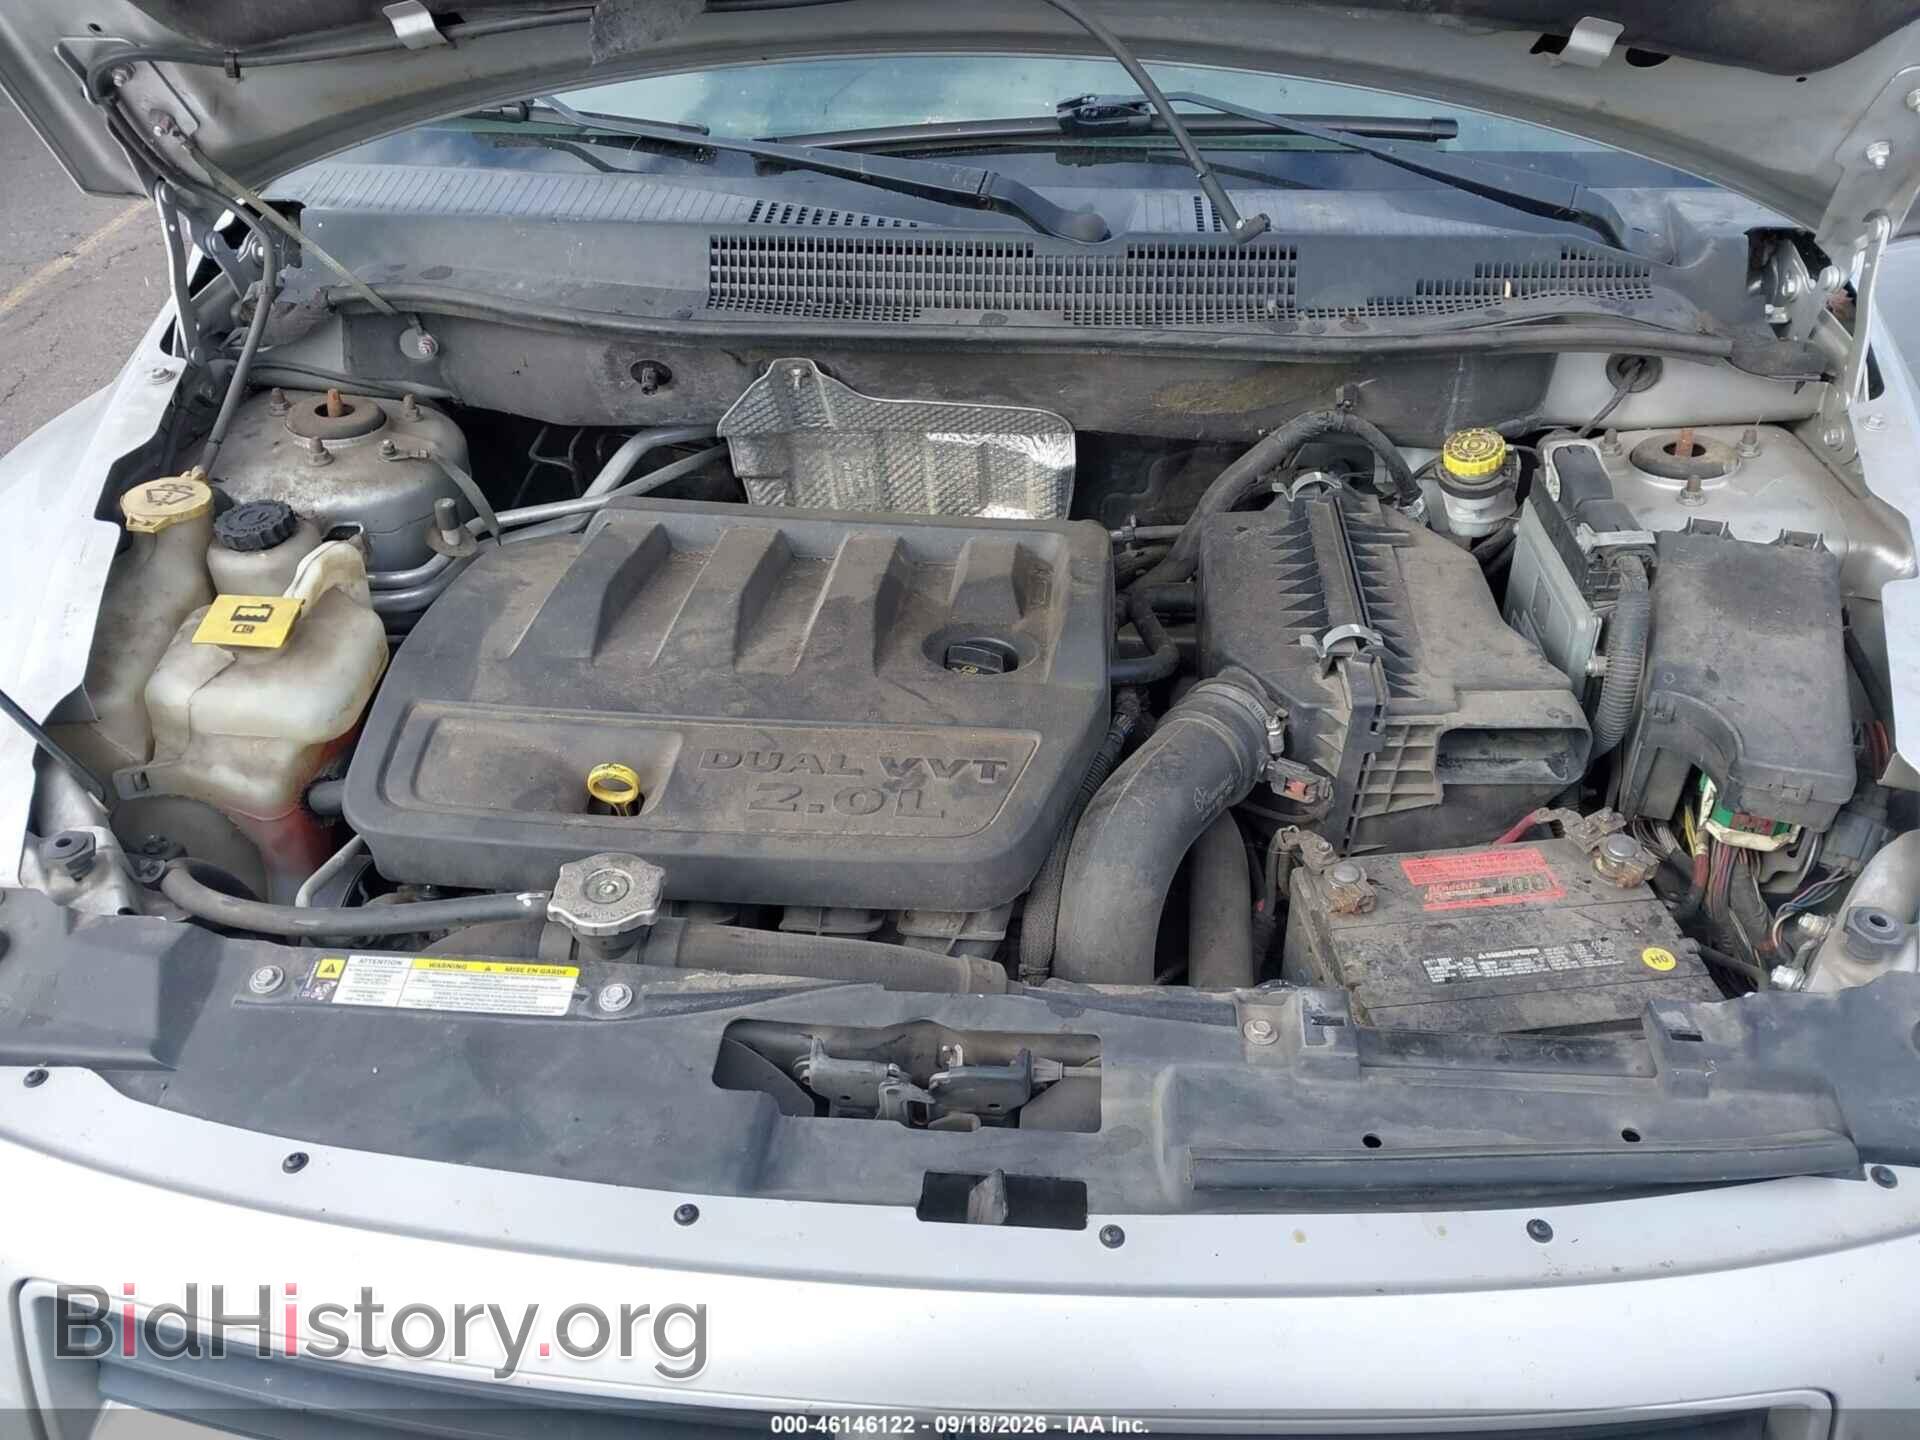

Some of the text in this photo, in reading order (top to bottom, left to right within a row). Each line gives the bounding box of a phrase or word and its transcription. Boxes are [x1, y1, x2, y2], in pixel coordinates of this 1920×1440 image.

[698, 748, 1009, 784] DUAL VVT
[747, 782, 945, 819] 2.0L
[358, 958, 403, 966] ATTENTION
[429, 962, 568, 976] WARNING MISE EN GARDE
